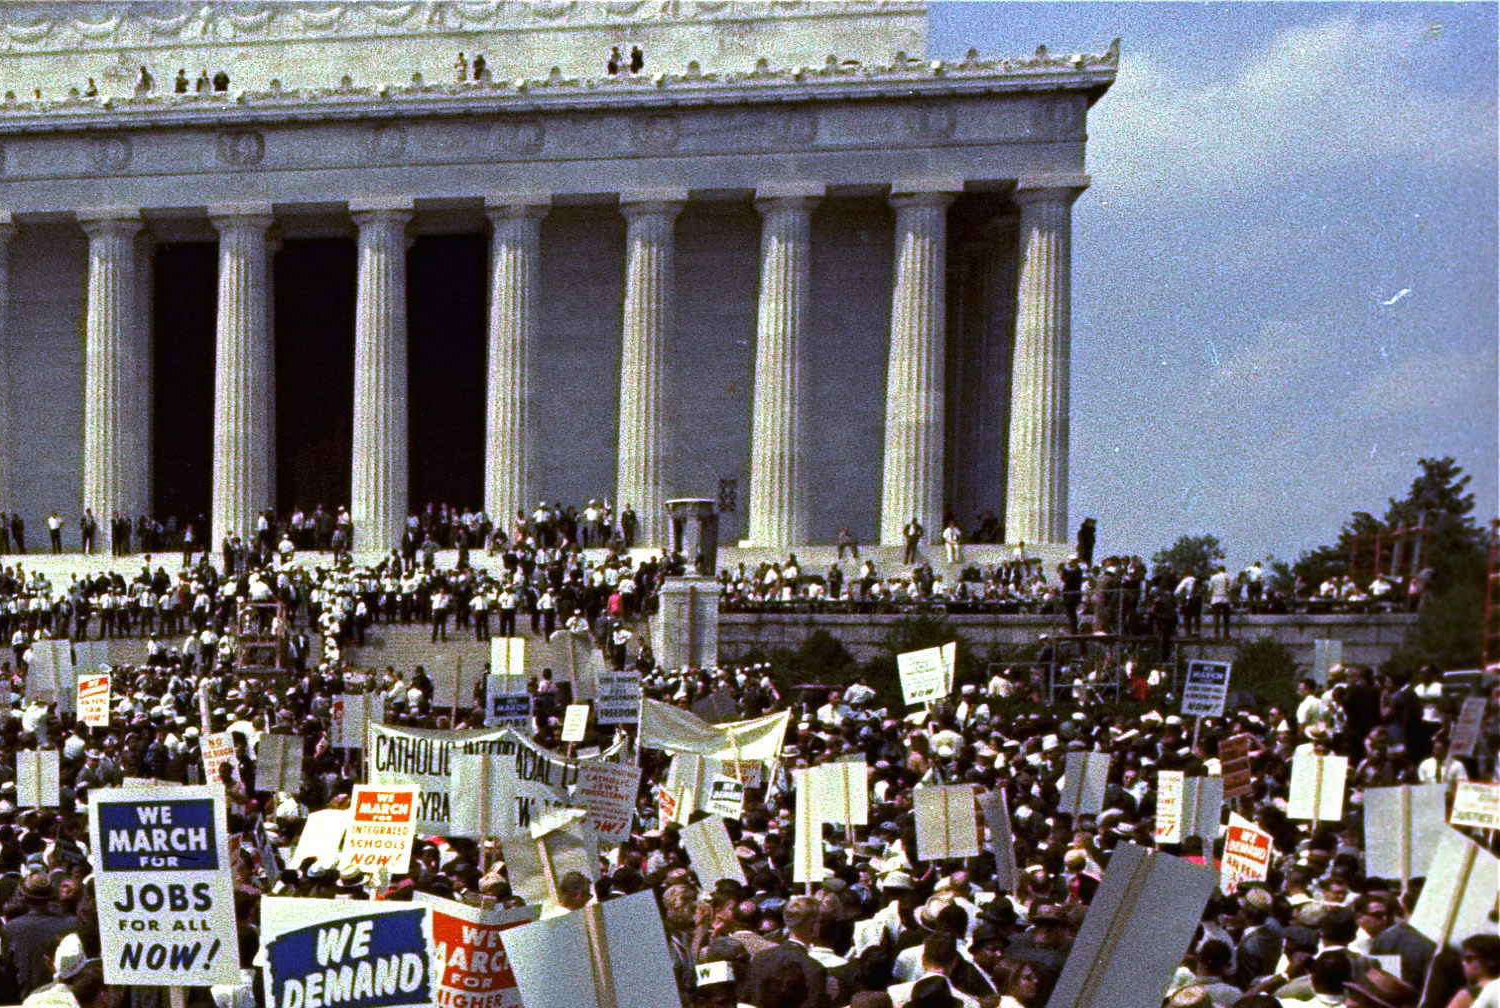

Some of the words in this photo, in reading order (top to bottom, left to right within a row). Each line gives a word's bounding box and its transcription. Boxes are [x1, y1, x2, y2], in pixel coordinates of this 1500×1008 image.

[377, 794, 394, 803] WE
[136, 805, 172, 825] WE
[359, 803, 408, 814] MARCH
[352, 825, 408, 836] INTEGRATED
[108, 827, 208, 852] MARCH
[350, 838, 405, 850] SCHOOLS
[139, 856, 179, 867] FOR
[351, 853, 402, 867] NOW!
[114, 882, 213, 912] JOBS
[119, 919, 160, 932] FOR
[172, 919, 212, 932] ALL
[316, 920, 374, 967] WE
[461, 925, 498, 949] WE
[120, 938, 221, 971] NOW!
[700, 967, 711, 979] W
[451, 973, 492, 988] FOR
